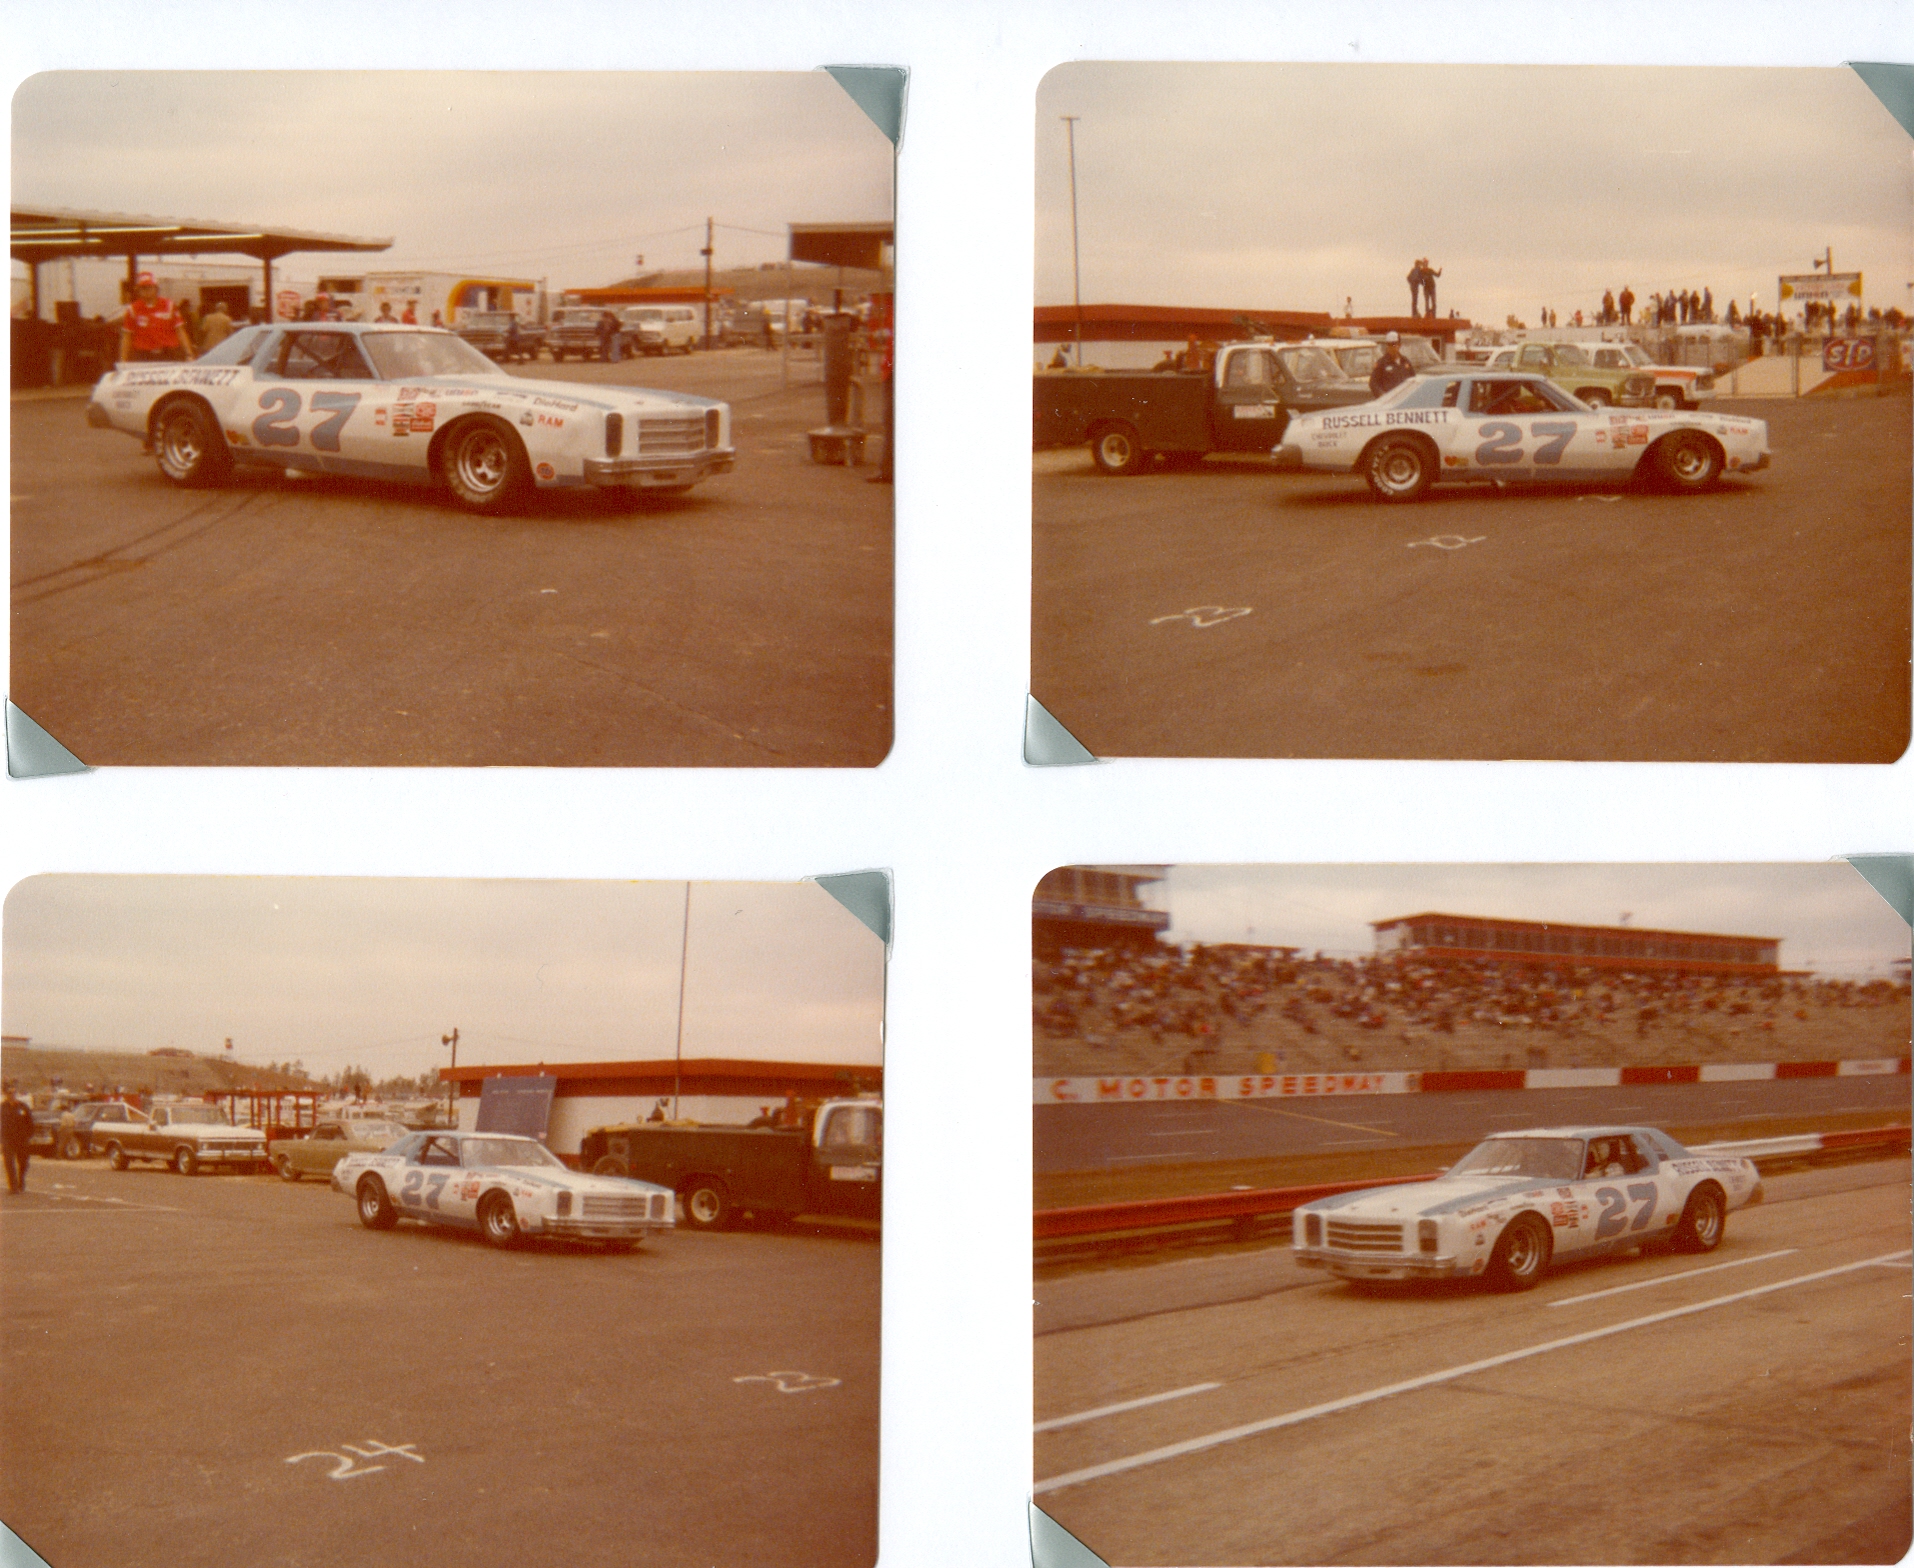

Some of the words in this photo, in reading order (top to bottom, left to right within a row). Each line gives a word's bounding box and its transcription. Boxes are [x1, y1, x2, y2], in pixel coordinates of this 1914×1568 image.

[1828, 340, 1872, 366] STP
[251, 387, 362, 453] 27
[538, 414, 564, 428] RAM
[1323, 413, 1381, 430] RUSSELL
[1386, 410, 1449, 425] BENNETT
[1475, 421, 1578, 466] 27
[1099, 1077, 1218, 1098] MOTOR
[1238, 1074, 1386, 1096] SPEEDWAY
[401, 1170, 450, 1209] 27
[1594, 1181, 1658, 1241] 27
[284, 1440, 425, 1479] 24
